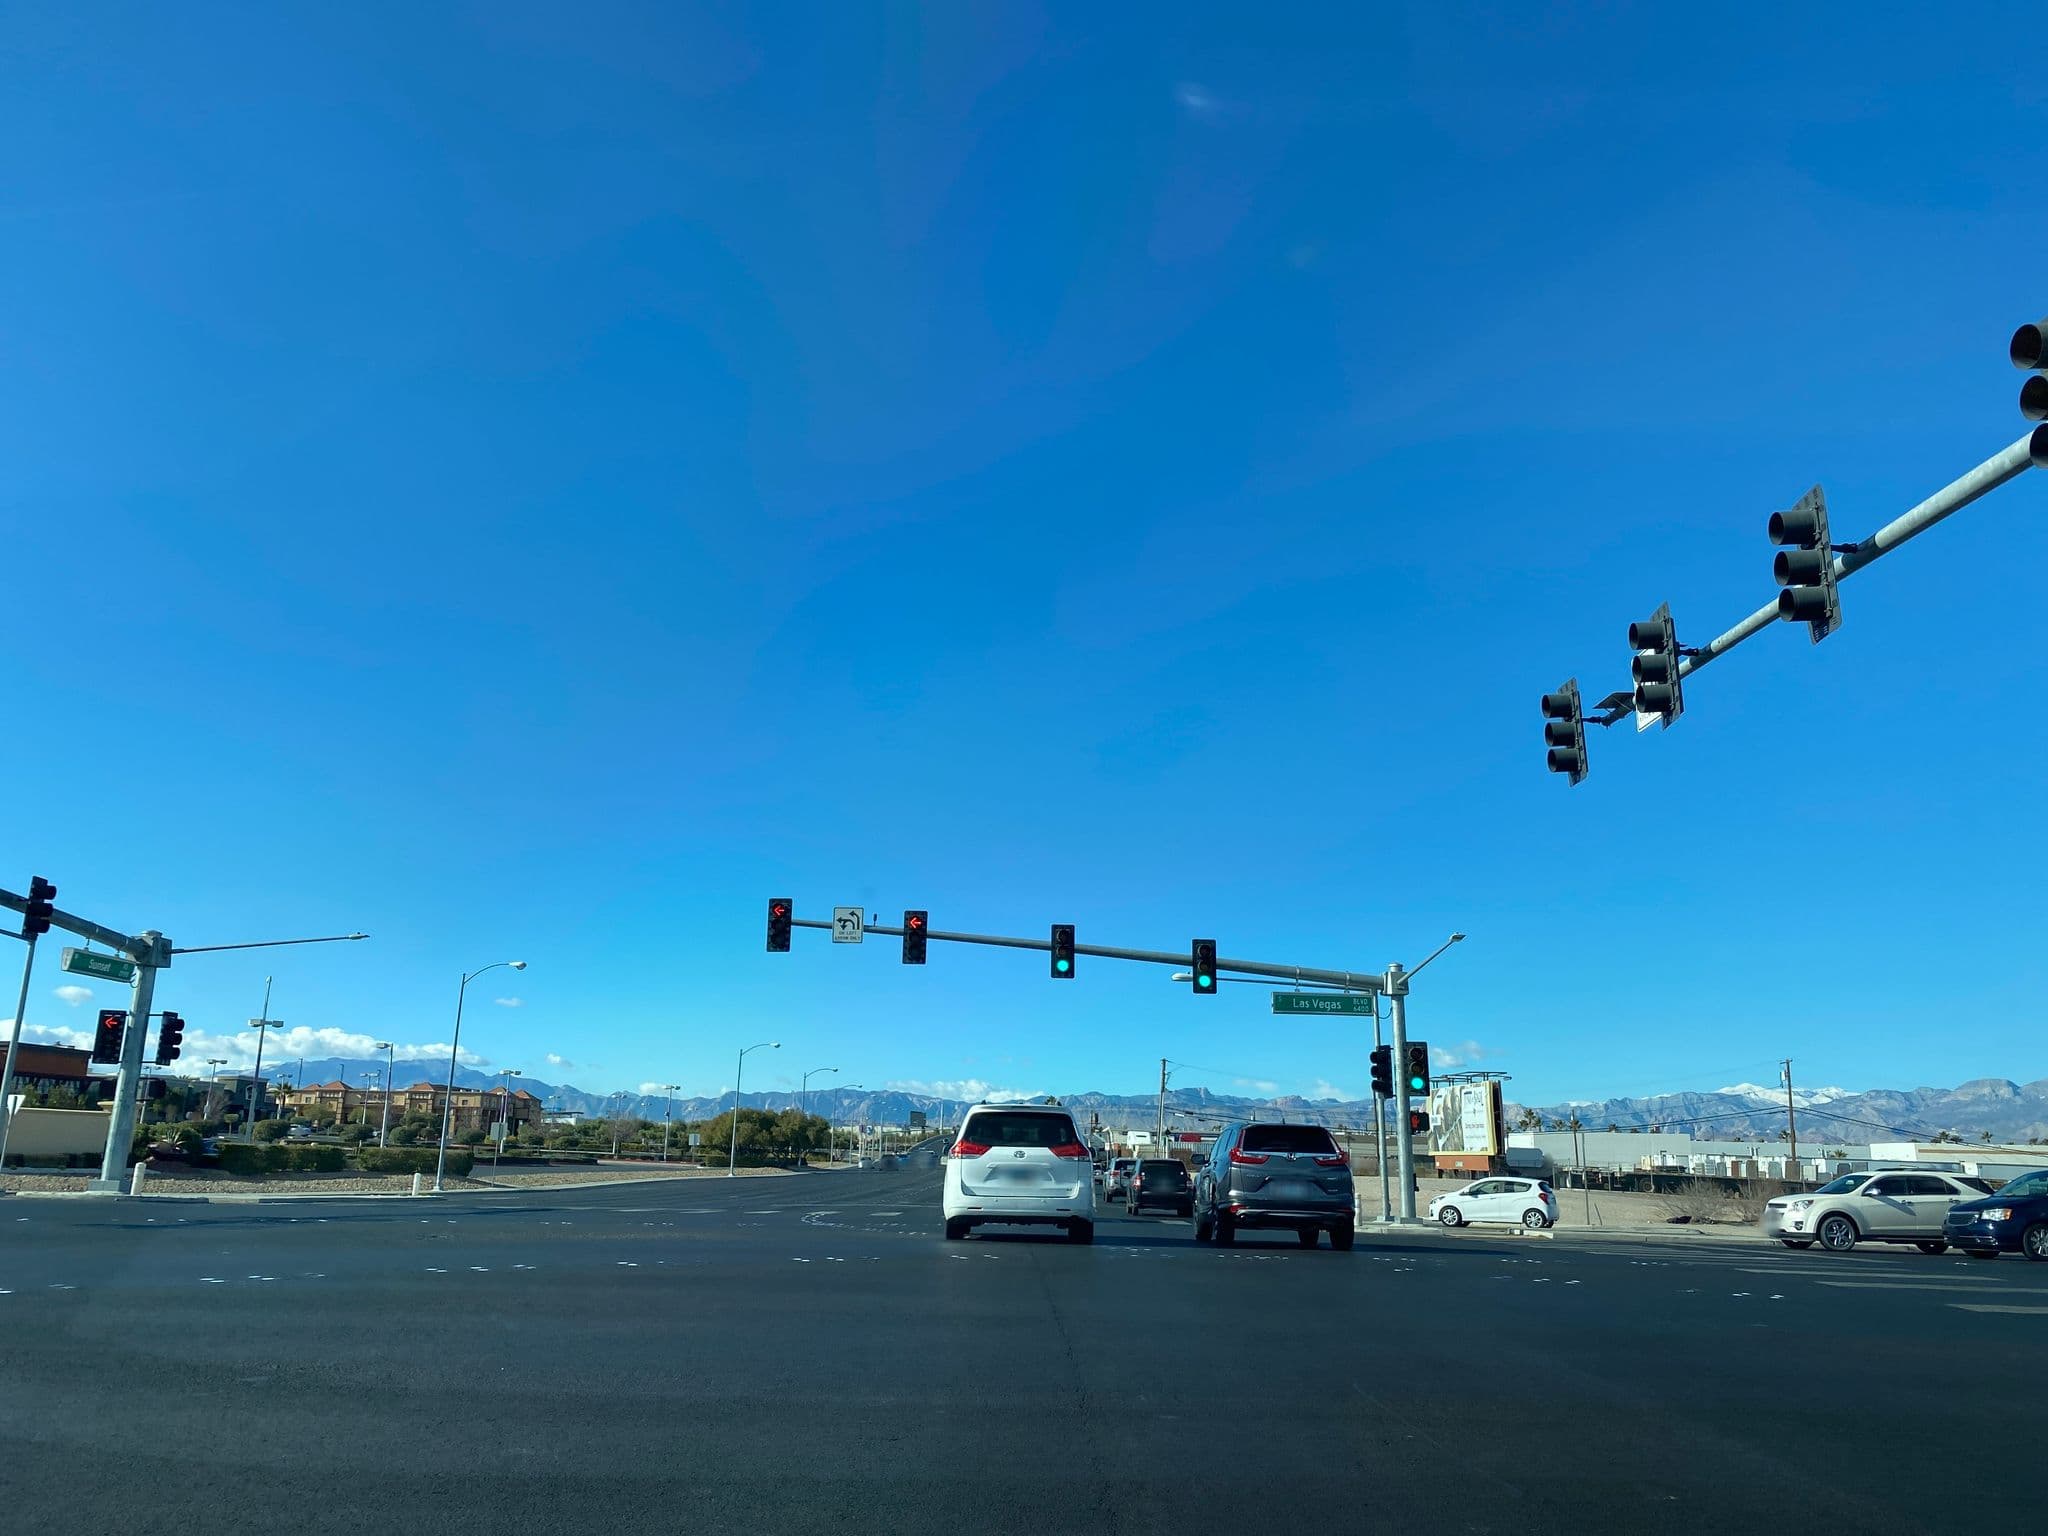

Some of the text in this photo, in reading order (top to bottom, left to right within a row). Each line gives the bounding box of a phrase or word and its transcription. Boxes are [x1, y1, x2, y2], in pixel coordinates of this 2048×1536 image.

[88, 959, 111, 972] Sunset
[1293, 998, 1309, 1008] Las
[1313, 999, 1342, 1011] Vegas
